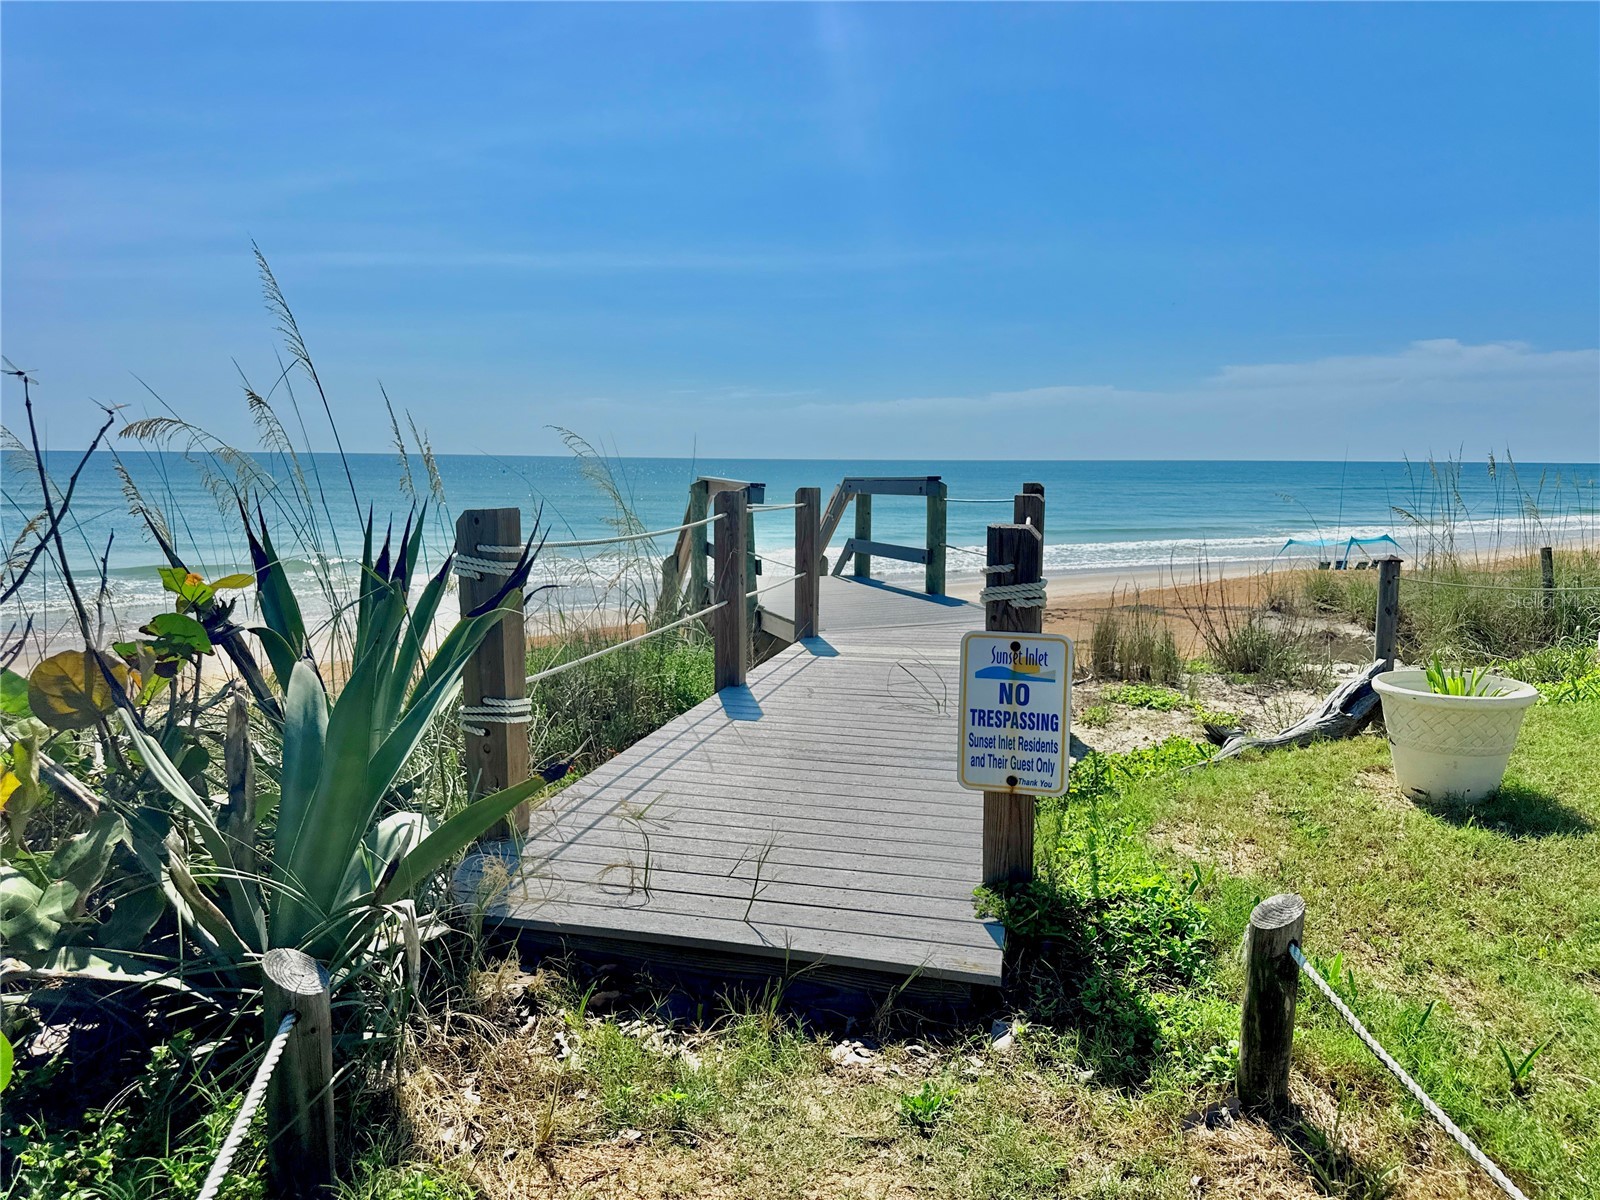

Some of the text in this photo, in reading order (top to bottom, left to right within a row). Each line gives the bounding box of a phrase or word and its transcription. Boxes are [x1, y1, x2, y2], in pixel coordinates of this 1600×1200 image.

[991, 646, 1048, 666] Sunset Inlet
[999, 683, 1030, 706] NO
[970, 709, 1059, 732] TRESPASSING
[969, 733, 1058, 754] Sunset Inlet Residents
[971, 754, 1055, 777] and Their Guest Only
[1018, 778, 1052, 788] Thank You
